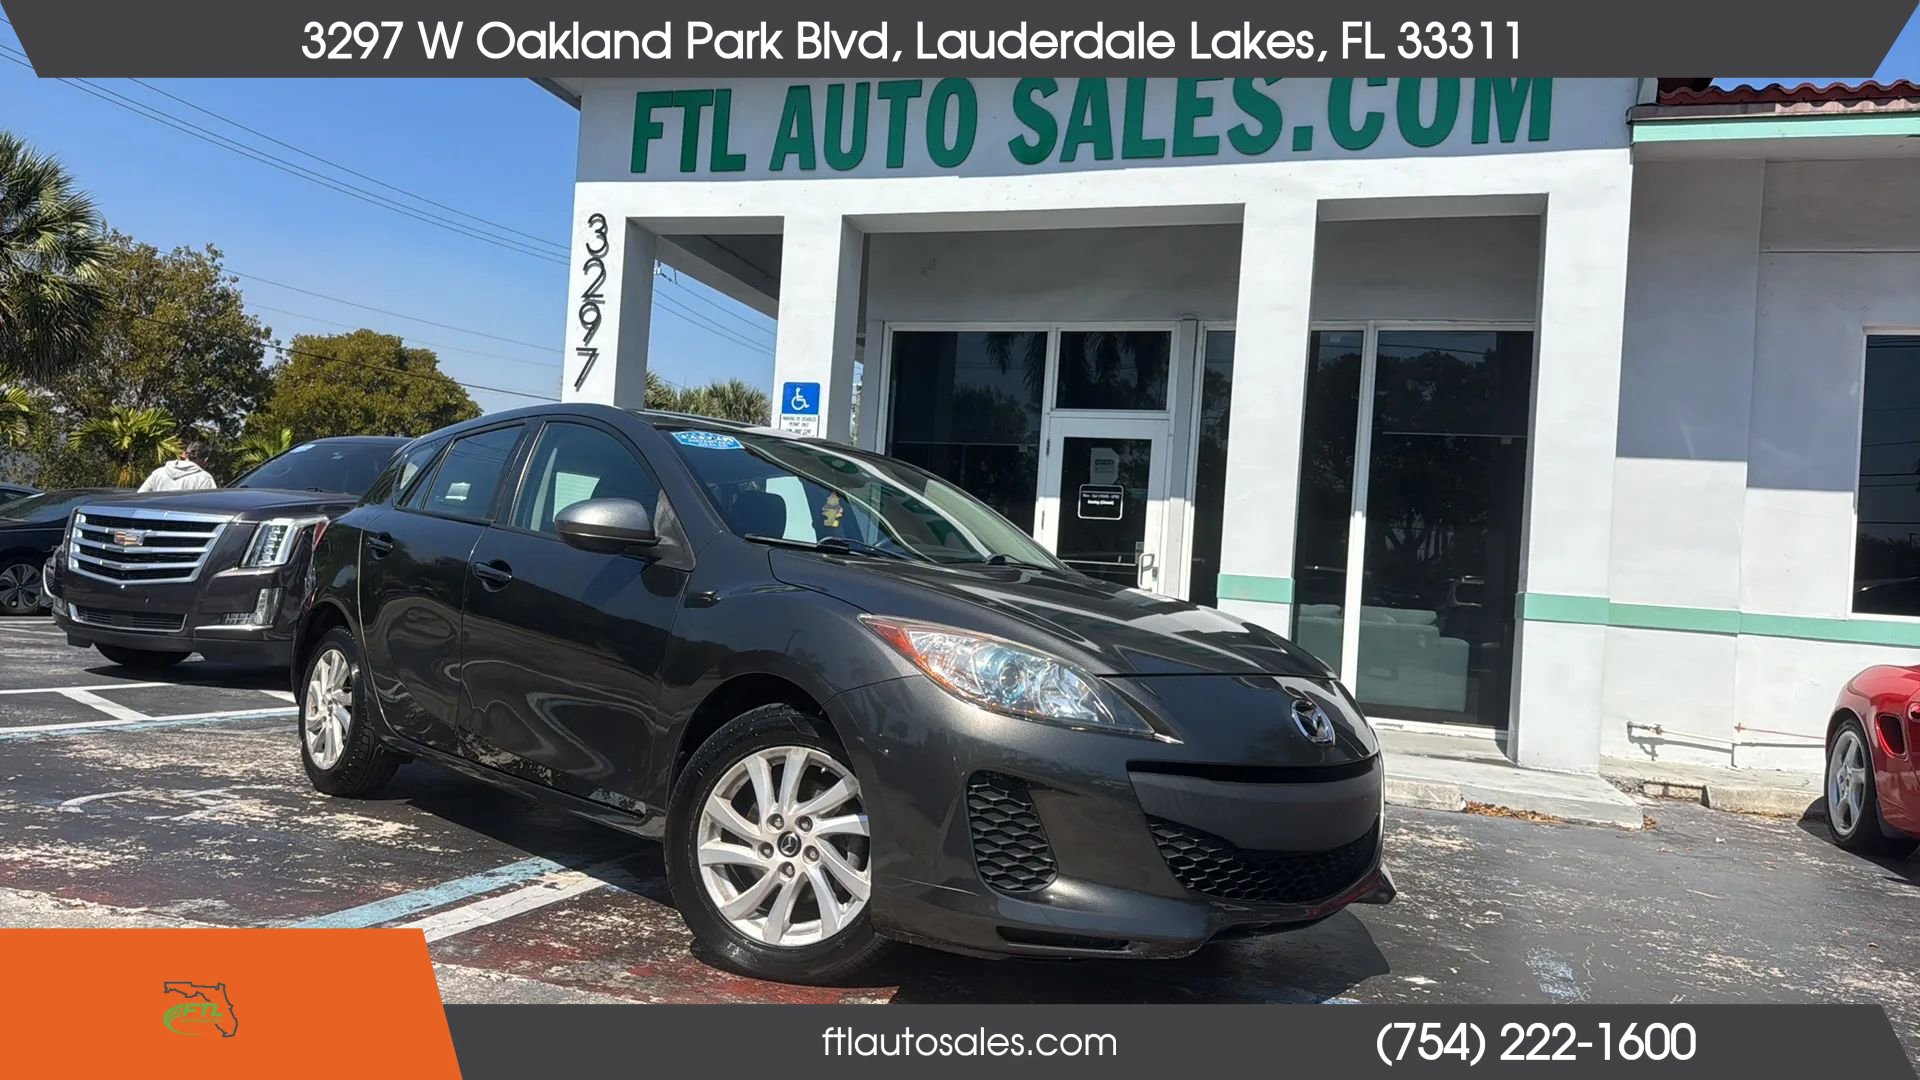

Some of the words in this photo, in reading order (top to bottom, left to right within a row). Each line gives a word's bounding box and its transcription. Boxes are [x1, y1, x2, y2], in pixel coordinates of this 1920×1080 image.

[630, 88, 747, 173] FTL
[769, 77, 978, 172] AUTO
[1007, 77, 1554, 166] SALES.COM
[574, 213, 608, 388] 3297
